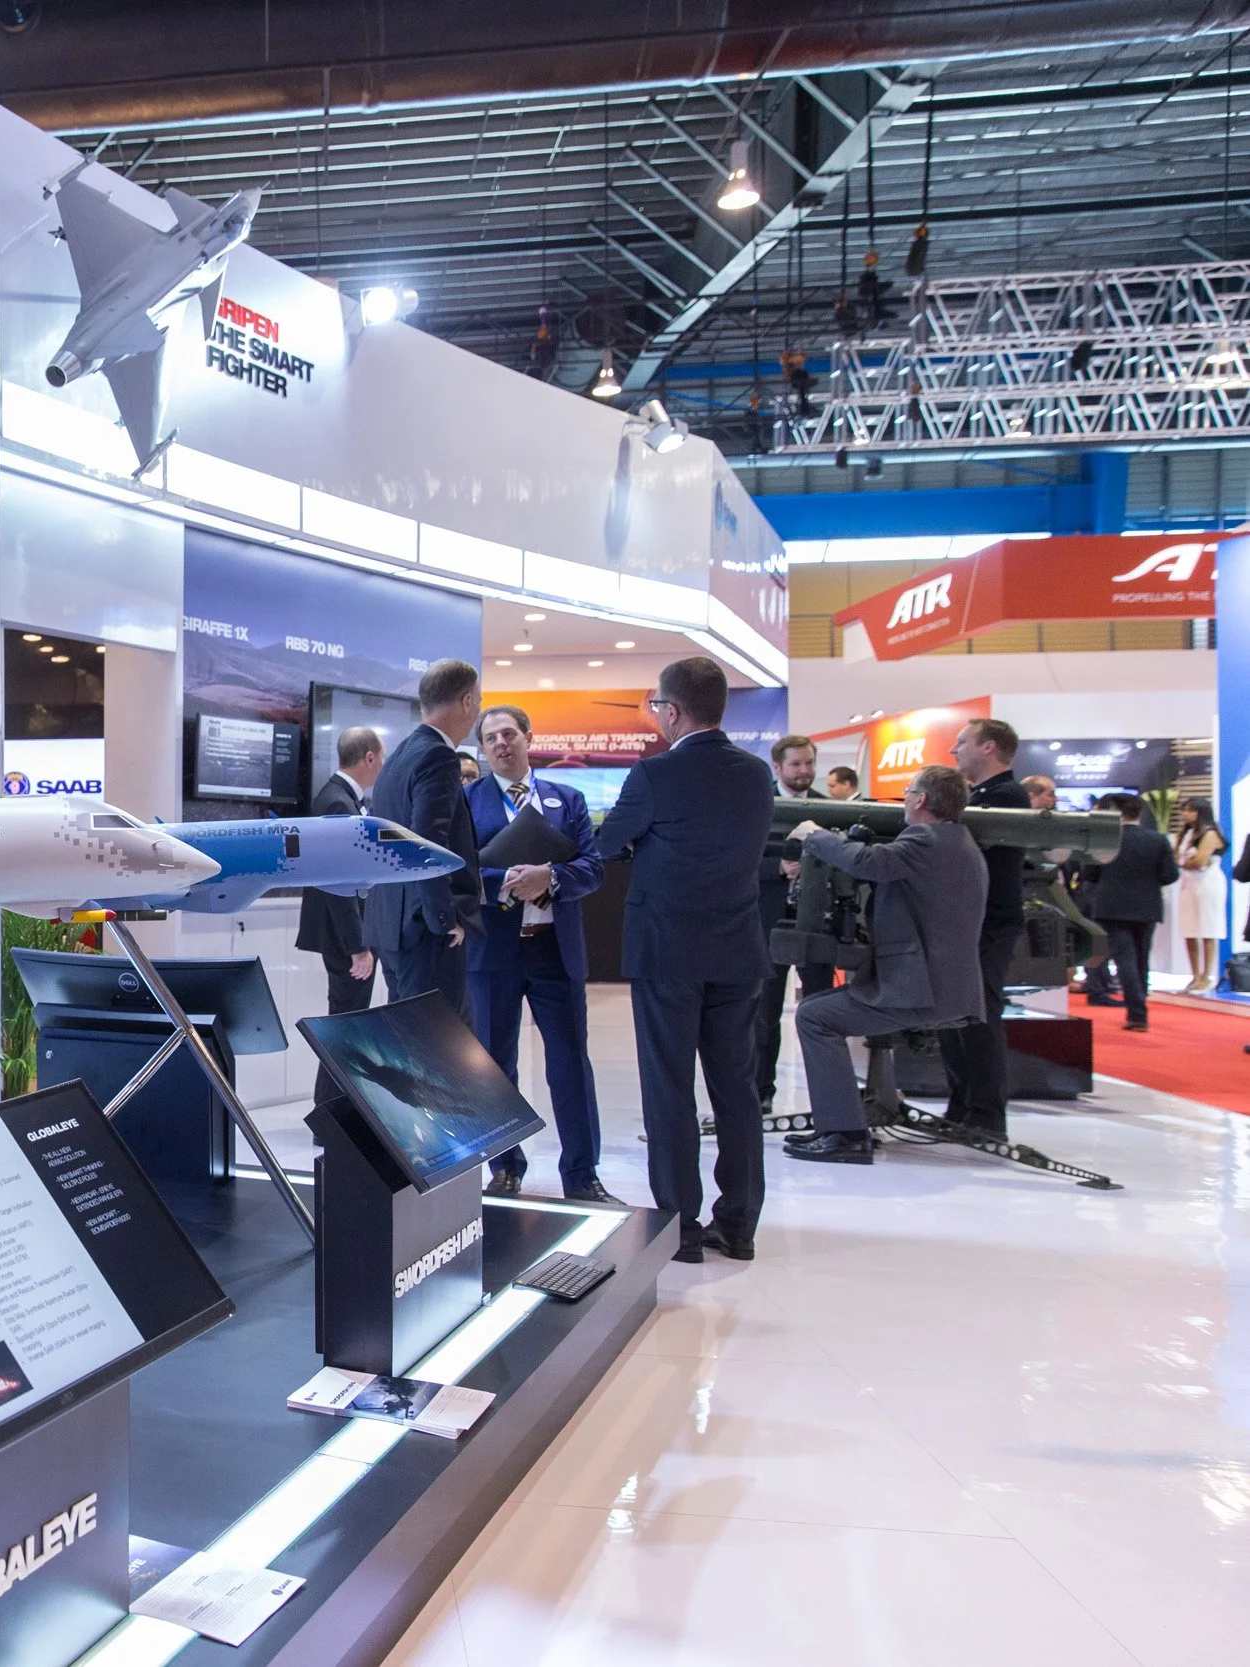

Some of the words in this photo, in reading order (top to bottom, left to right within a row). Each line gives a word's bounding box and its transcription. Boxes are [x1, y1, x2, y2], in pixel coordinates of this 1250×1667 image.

[211, 320, 246, 354] THE
[249, 338, 314, 383] SMART
[206, 344, 287, 398] FIGHTER
[886, 573, 952, 629] ATR
[1111, 591, 1184, 603] PROPELLING
[1187, 590, 1211, 601] THE
[183, 615, 232, 639] GIRAFFE
[234, 626, 249, 641] 1X
[285, 635, 309, 652] RBS
[310, 640, 326, 655] 70
[327, 643, 345, 658] NG
[573, 742, 608, 751] SUITE
[589, 733, 609, 743] AIR
[610, 733, 658, 743] TRAFFIC
[877, 738, 926, 770] ATR
[36, 780, 102, 794] SAAB
[267, 825, 301, 835] MPA
[27, 1118, 78, 1141] GLOBALEYE
[394, 1231, 461, 1298] SWORDFISH
[461, 1216, 484, 1250] MPA
